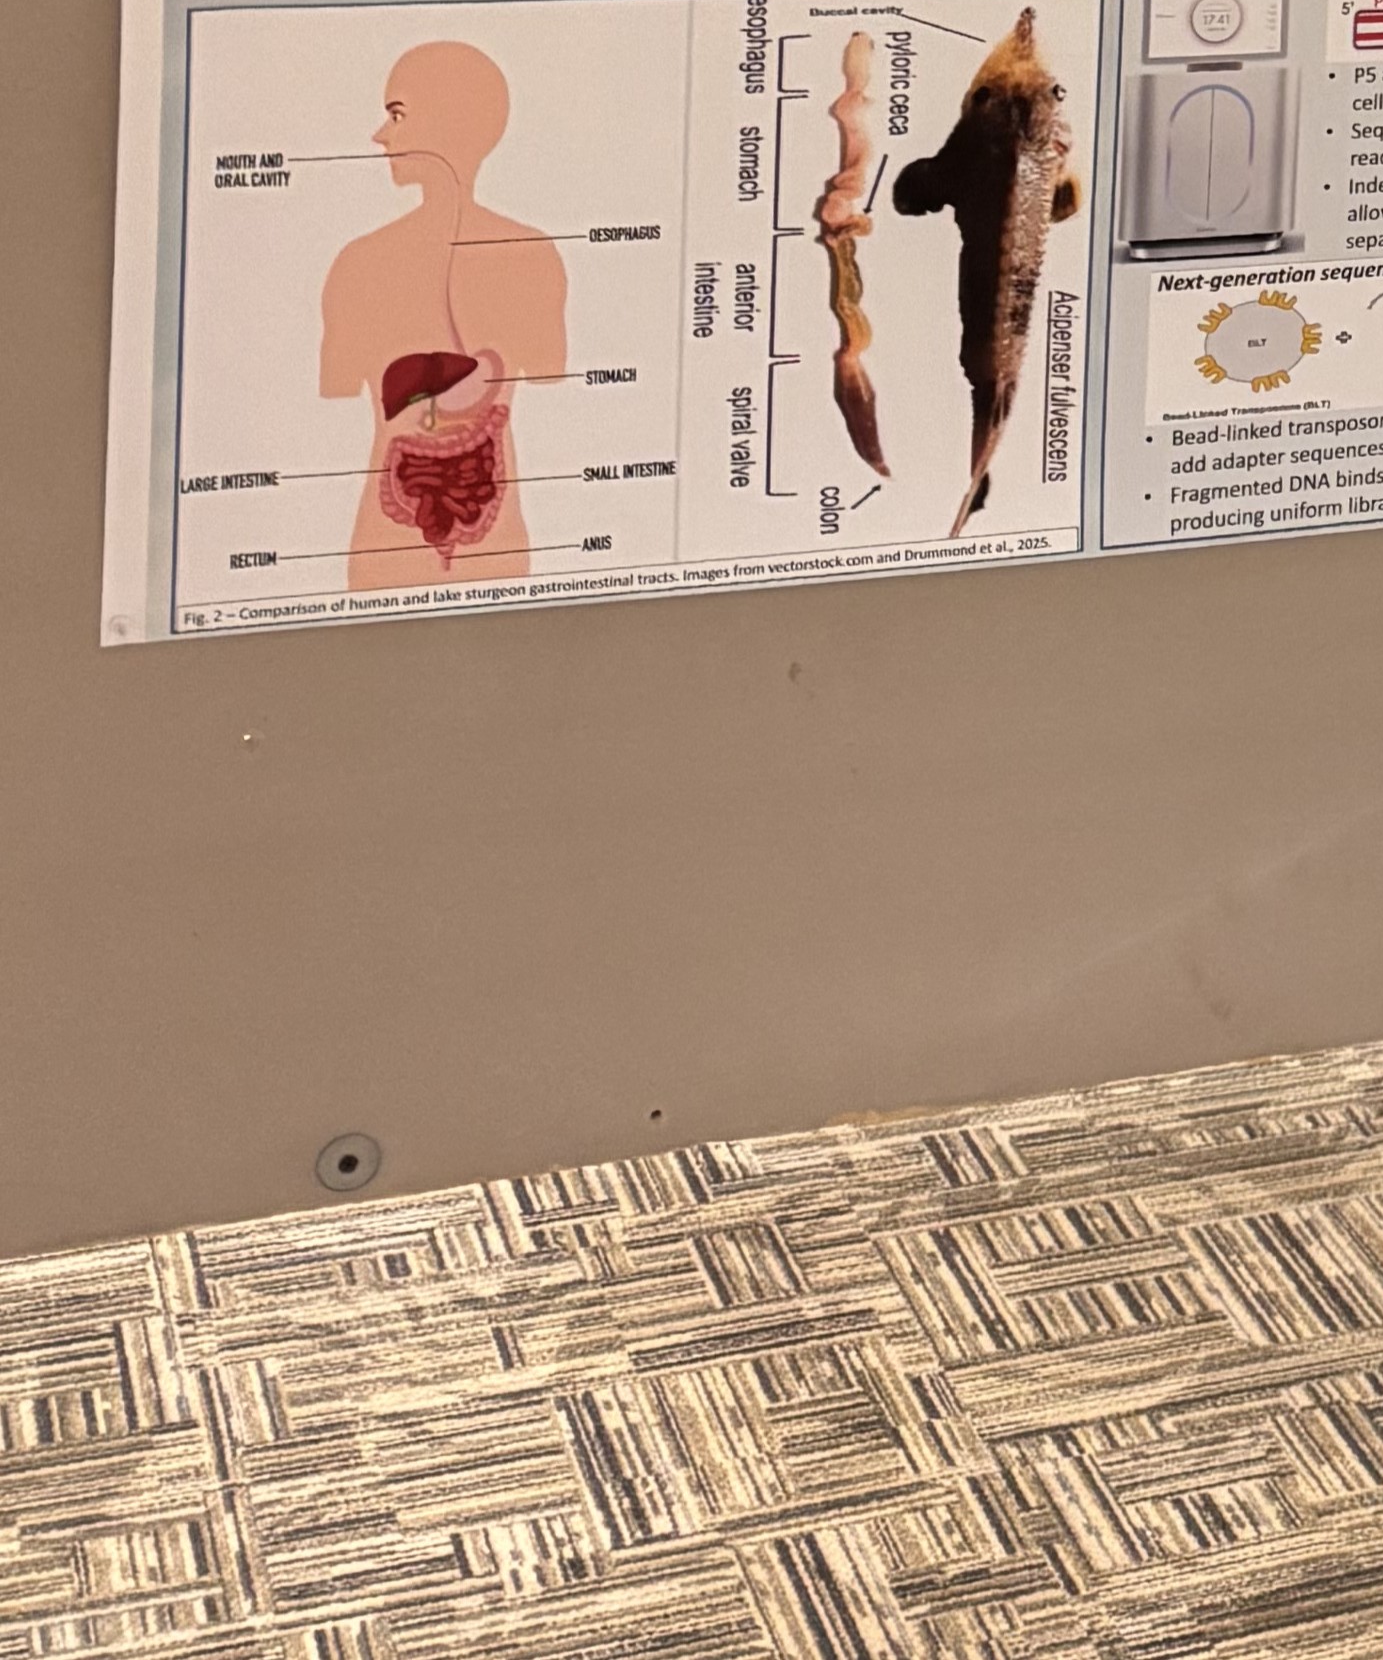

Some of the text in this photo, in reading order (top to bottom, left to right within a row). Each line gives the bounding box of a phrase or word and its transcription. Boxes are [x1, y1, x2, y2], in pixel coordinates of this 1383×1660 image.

[885, 30, 913, 136] pyloric ceca
[215, 152, 284, 171] MOUTH AND
[738, 124, 764, 202] stomach
[214, 170, 291, 189] ORAL CAVITY
[588, 224, 661, 243] OESOPHAGUS
[1157, 266, 1316, 293] Next-generation
[693, 262, 721, 339] intestine
[735, 263, 756, 332] anterior
[585, 367, 637, 386] STOMACH
[1047, 290, 1081, 482] Acipenser fulvescens
[728, 386, 755, 488] spiral valve
[177, 471, 280, 498] LARGE INTESTINE
[583, 460, 677, 482] SMALL INTESTINE
[820, 486, 841, 535] colon
[581, 534, 612, 552] ANUS
[229, 551, 277, 570] RECTUM
